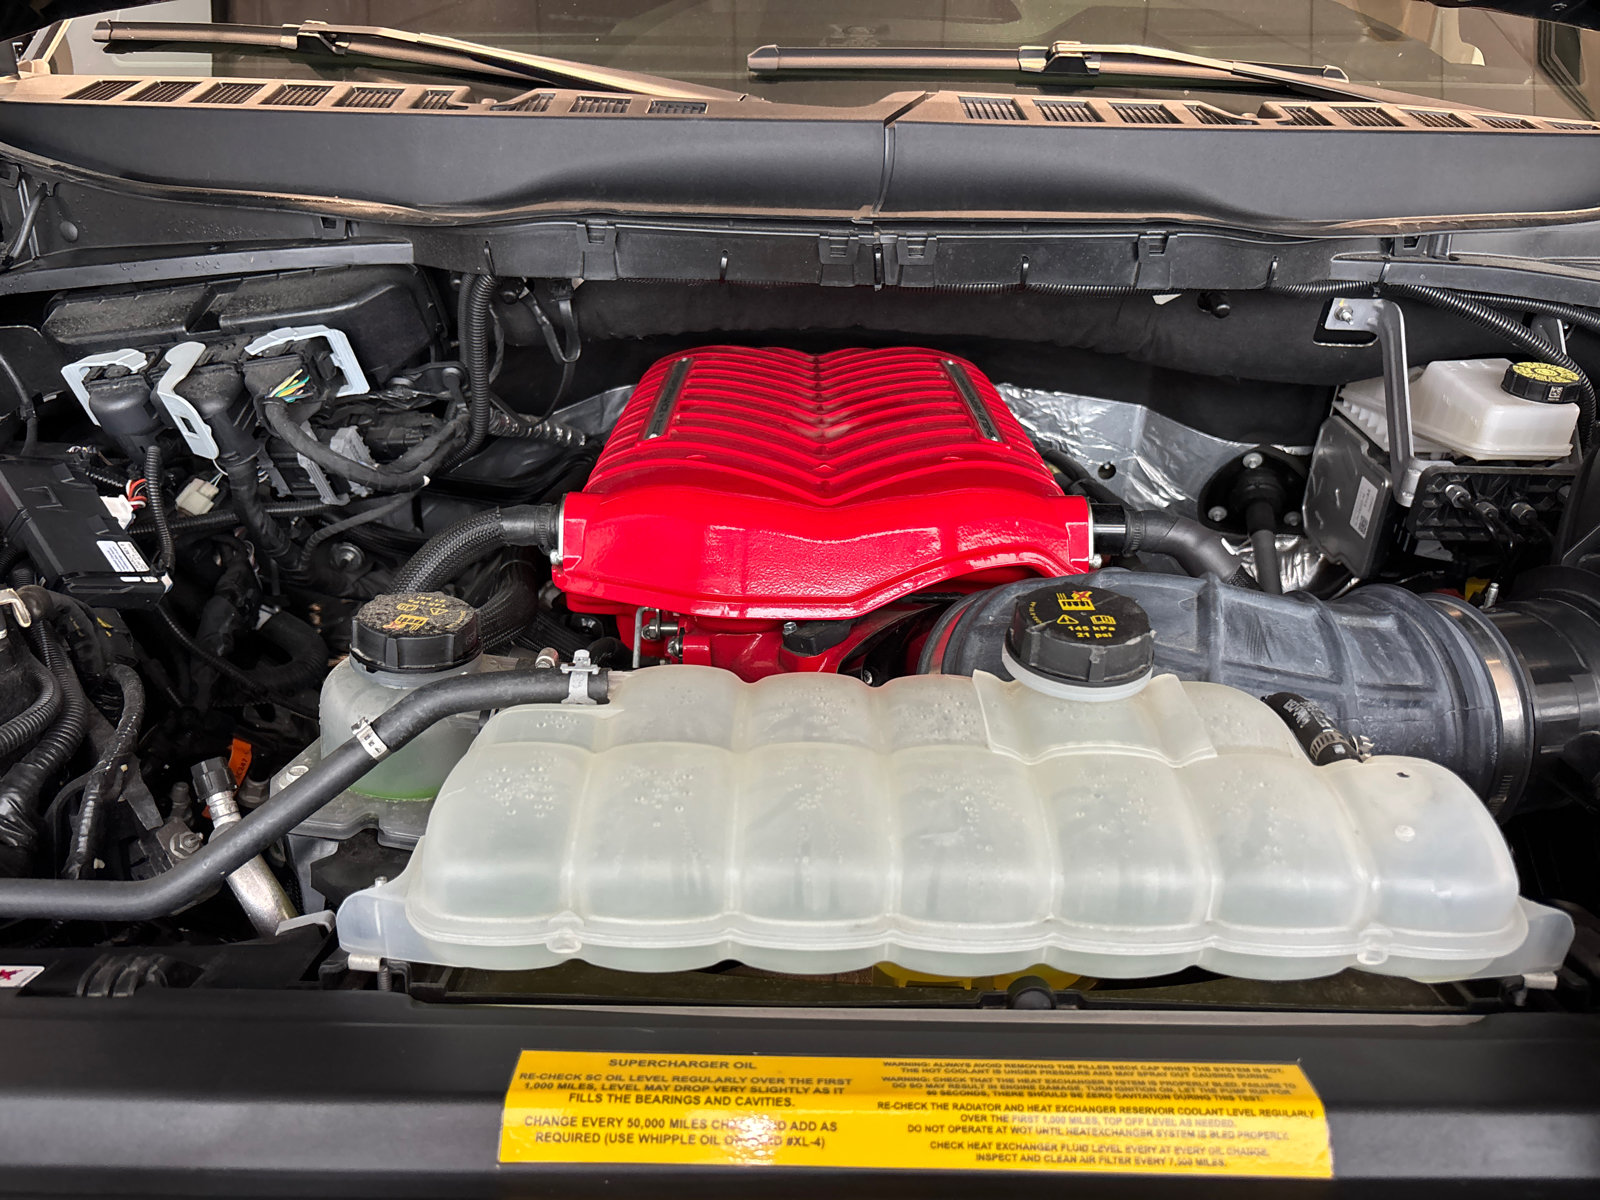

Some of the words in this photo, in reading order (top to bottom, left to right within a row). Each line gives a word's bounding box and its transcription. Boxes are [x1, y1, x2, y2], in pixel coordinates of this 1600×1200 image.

[609, 1059, 729, 1068] SUPERCHARGER
[733, 1060, 756, 1069] OIL
[519, 1073, 582, 1081] RE-CHECK
[629, 1074, 667, 1082] LEVEL
[672, 1075, 747, 1083] REGULARLY
[750, 1076, 785, 1084] OVER
[817, 1077, 852, 1085] FIRST
[557, 1083, 597, 1091] MILES,
[601, 1083, 639, 1091] LEVEL
[674, 1084, 710, 1092] DROP
[750, 1085, 811, 1093] SLIGHTLY
[833, 1086, 845, 1094] IT
[569, 1093, 603, 1104] FILLS
[608, 1094, 631, 1104] THE
[635, 1094, 701, 1105] BEARINGS
[704, 1095, 731, 1105] AND
[735, 1096, 795, 1106] CAVITIES.
[877, 1102, 927, 1110] RE-CHECK
[931, 1103, 949, 1111] THE
[952, 1103, 1001, 1112] RADIATOR
[1004, 1104, 1024, 1112] AND
[1027, 1104, 1052, 1113] HEAT
[1055, 1105, 1116, 1114] EXCHANGER
[1119, 1106, 1175, 1115] RESERVOIR
[1177, 1107, 1224, 1115] COOLANT
[1226, 1108, 1256, 1116] LEVEL
[1259, 1108, 1314, 1117] REGULARLY
[524, 1116, 577, 1127] CHANGE
[582, 1117, 623, 1128] EVERY
[627, 1117, 665, 1129] 50,000
[669, 1118, 707, 1129] MILES
[790, 1120, 817, 1131] ADD
[820, 1121, 837, 1131] AS
[536, 1132, 601, 1143] REQUIRED
[604, 1133, 634, 1146] (USE
[638, 1134, 696, 1144] WHIPPLE
[700, 1135, 719, 1145] OIL
[786, 1136, 825, 1150] #XL-4)
[976, 1154, 1017, 1162] INSPECT
[1134, 1157, 1165, 1165] EVERY
